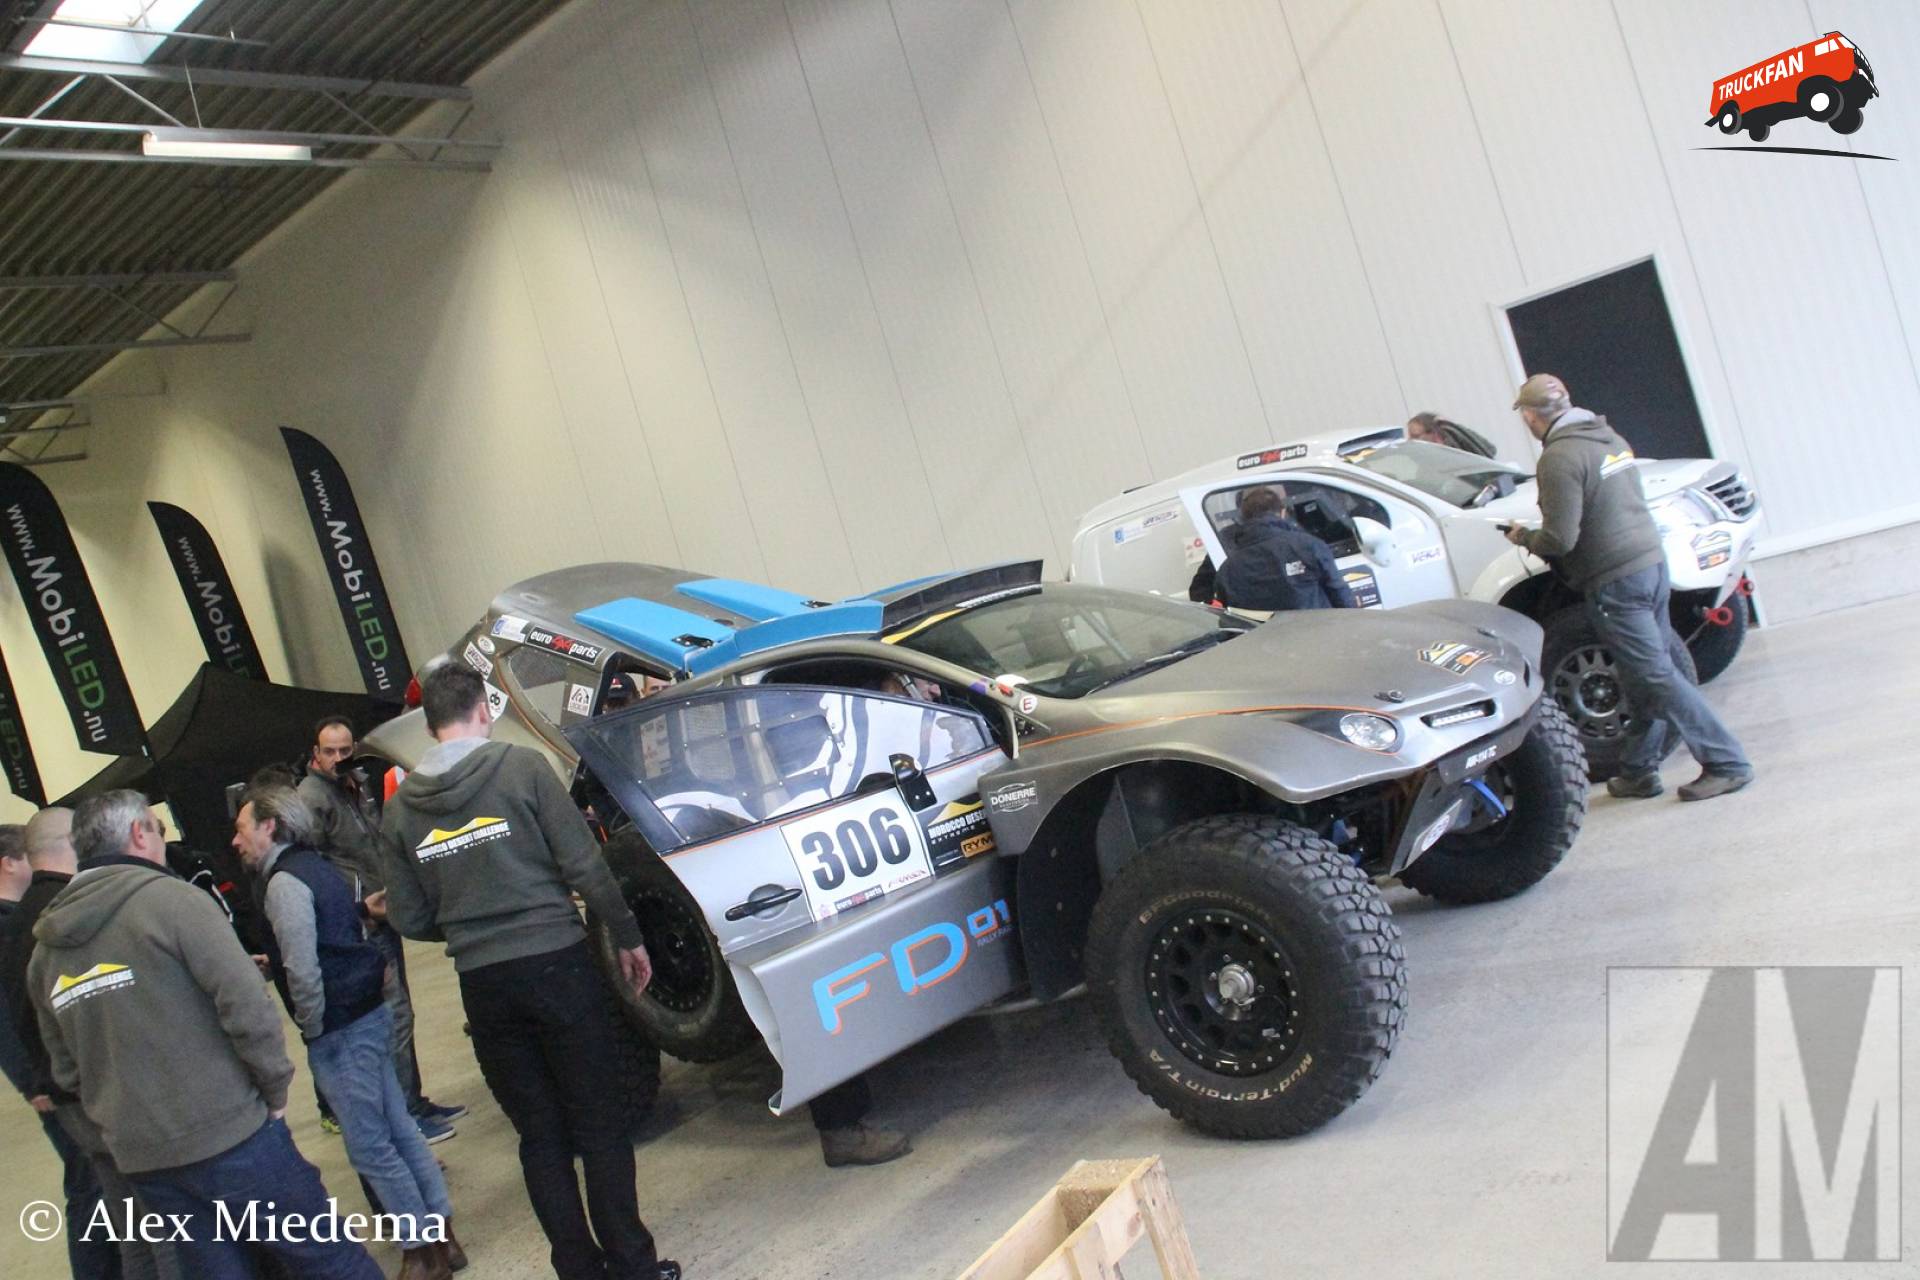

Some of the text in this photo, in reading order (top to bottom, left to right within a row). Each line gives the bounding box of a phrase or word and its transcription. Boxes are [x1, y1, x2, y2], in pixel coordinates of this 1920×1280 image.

[308, 468, 391, 691] www.MobiLED.nu
[6, 503, 107, 743] www.MobiLED.nu
[928, 818, 966, 839] MOROCCO
[991, 787, 1036, 805] DONERRE
[801, 807, 911, 891] 306
[1185, 1053, 1313, 1101] Mud-Terrain
